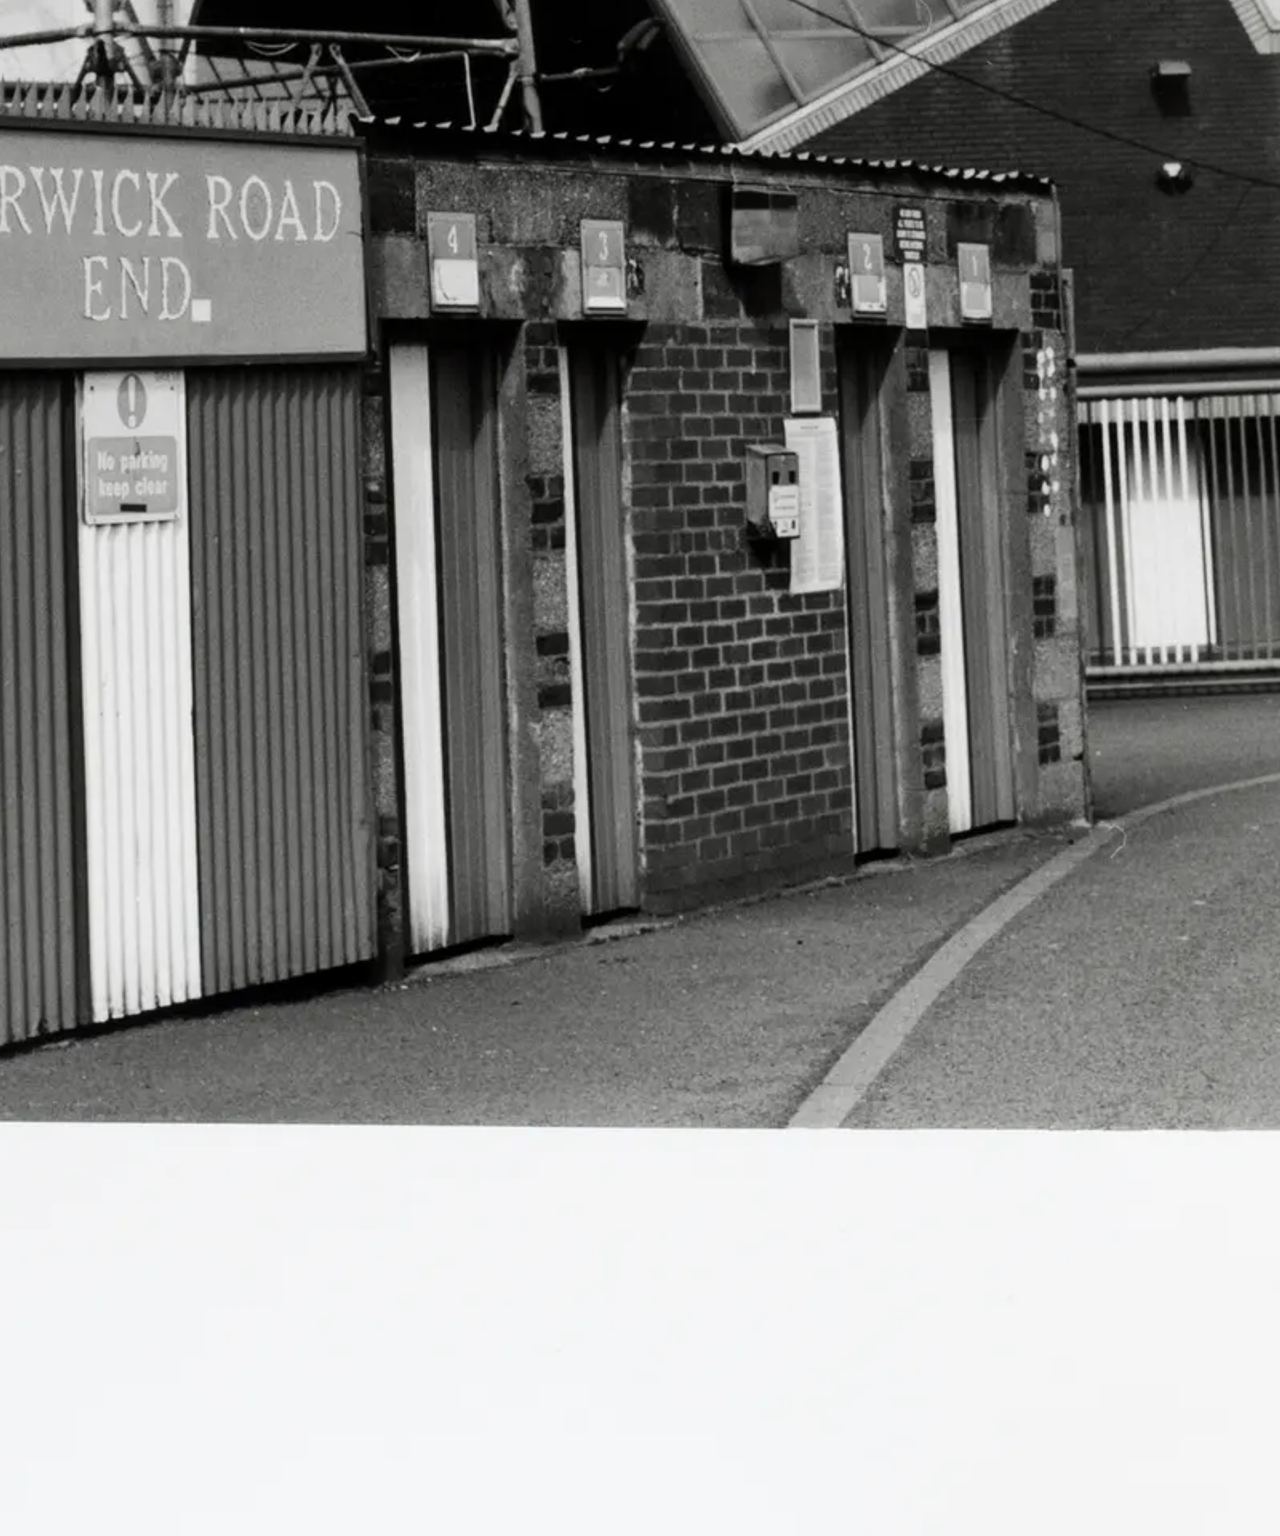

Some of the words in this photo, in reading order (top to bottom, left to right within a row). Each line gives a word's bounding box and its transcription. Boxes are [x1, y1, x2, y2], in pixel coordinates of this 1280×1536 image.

[206, 175, 342, 242] ROAD
[446, 224, 458, 254] 4
[599, 230, 609, 261] 3
[862, 243, 872, 270] 2
[97, 451, 115, 471] No
[119, 449, 168, 474] parking
[98, 478, 130, 500] keep
[134, 476, 168, 497] clear
